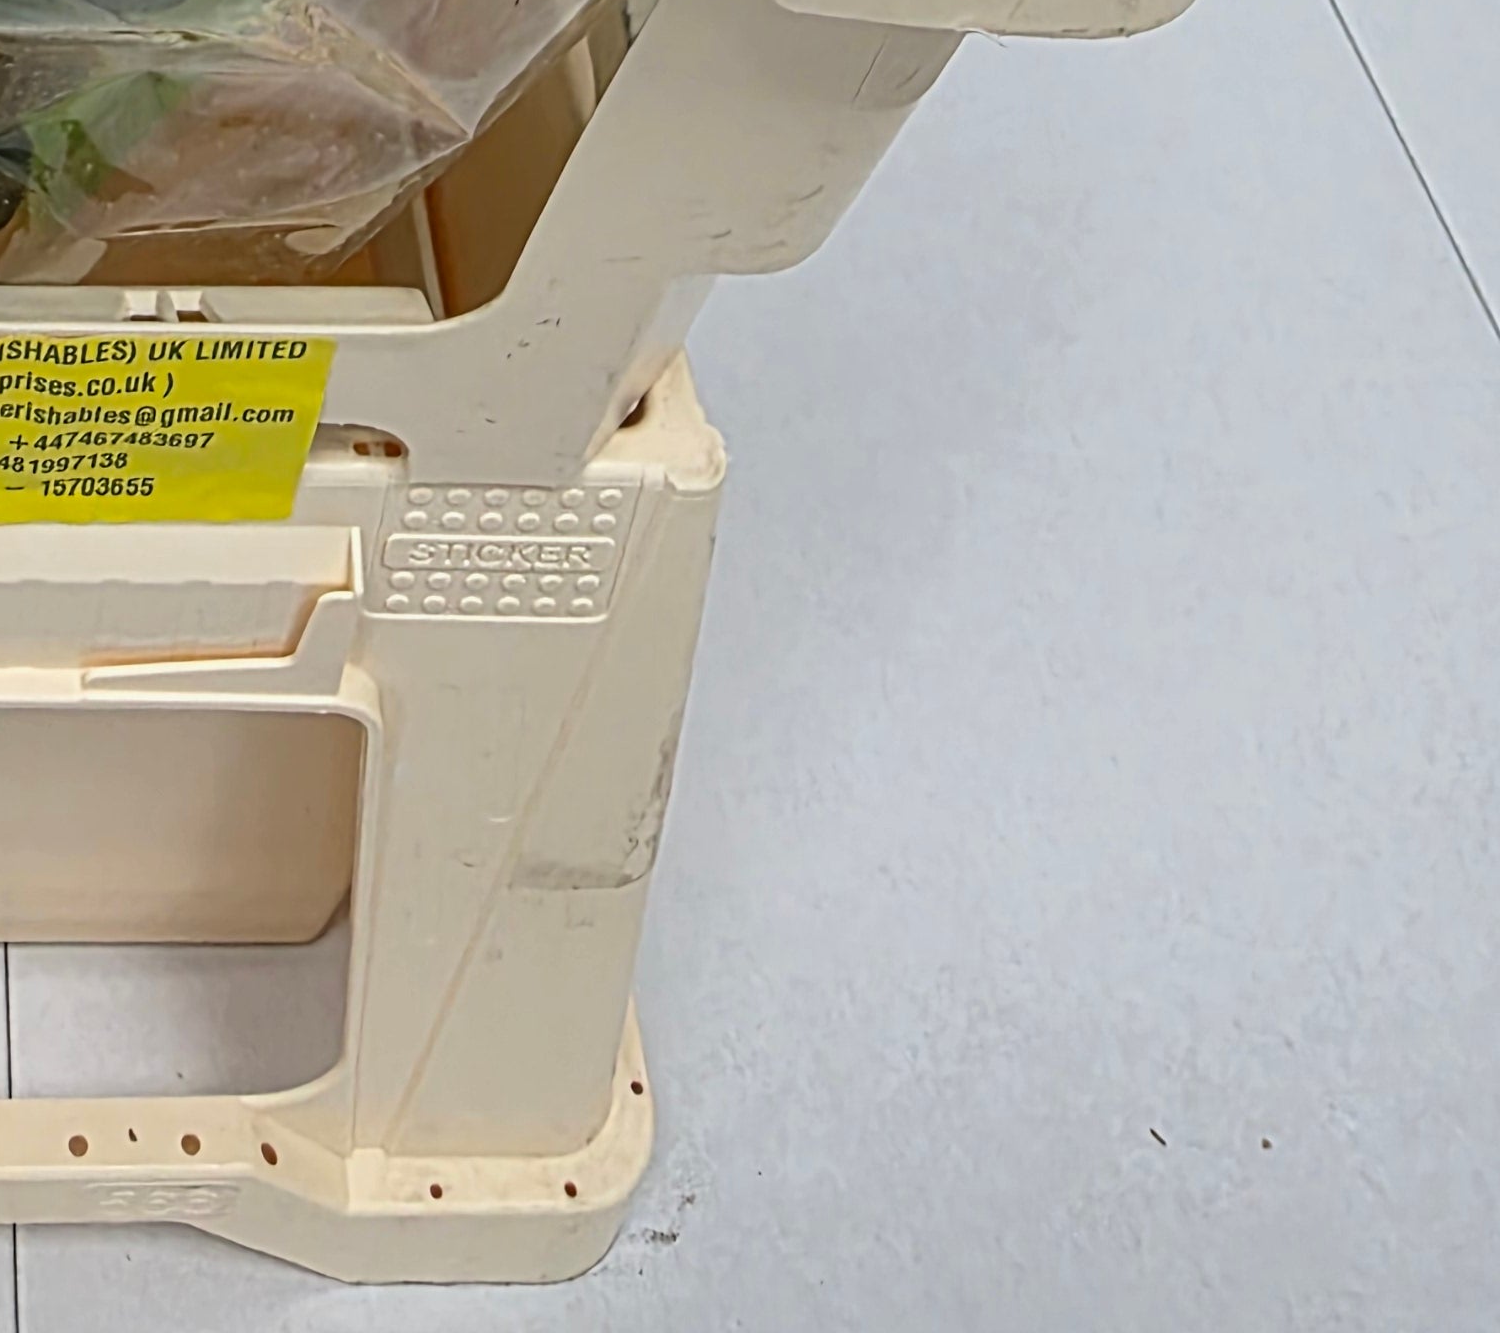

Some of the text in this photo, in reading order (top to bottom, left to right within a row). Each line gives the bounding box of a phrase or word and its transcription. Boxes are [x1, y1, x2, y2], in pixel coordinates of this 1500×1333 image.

[149, 340, 189, 361] UK
[195, 340, 307, 360] LIMITED
[41, 477, 156, 497] 15703655
[406, 542, 593, 569] STICKER
